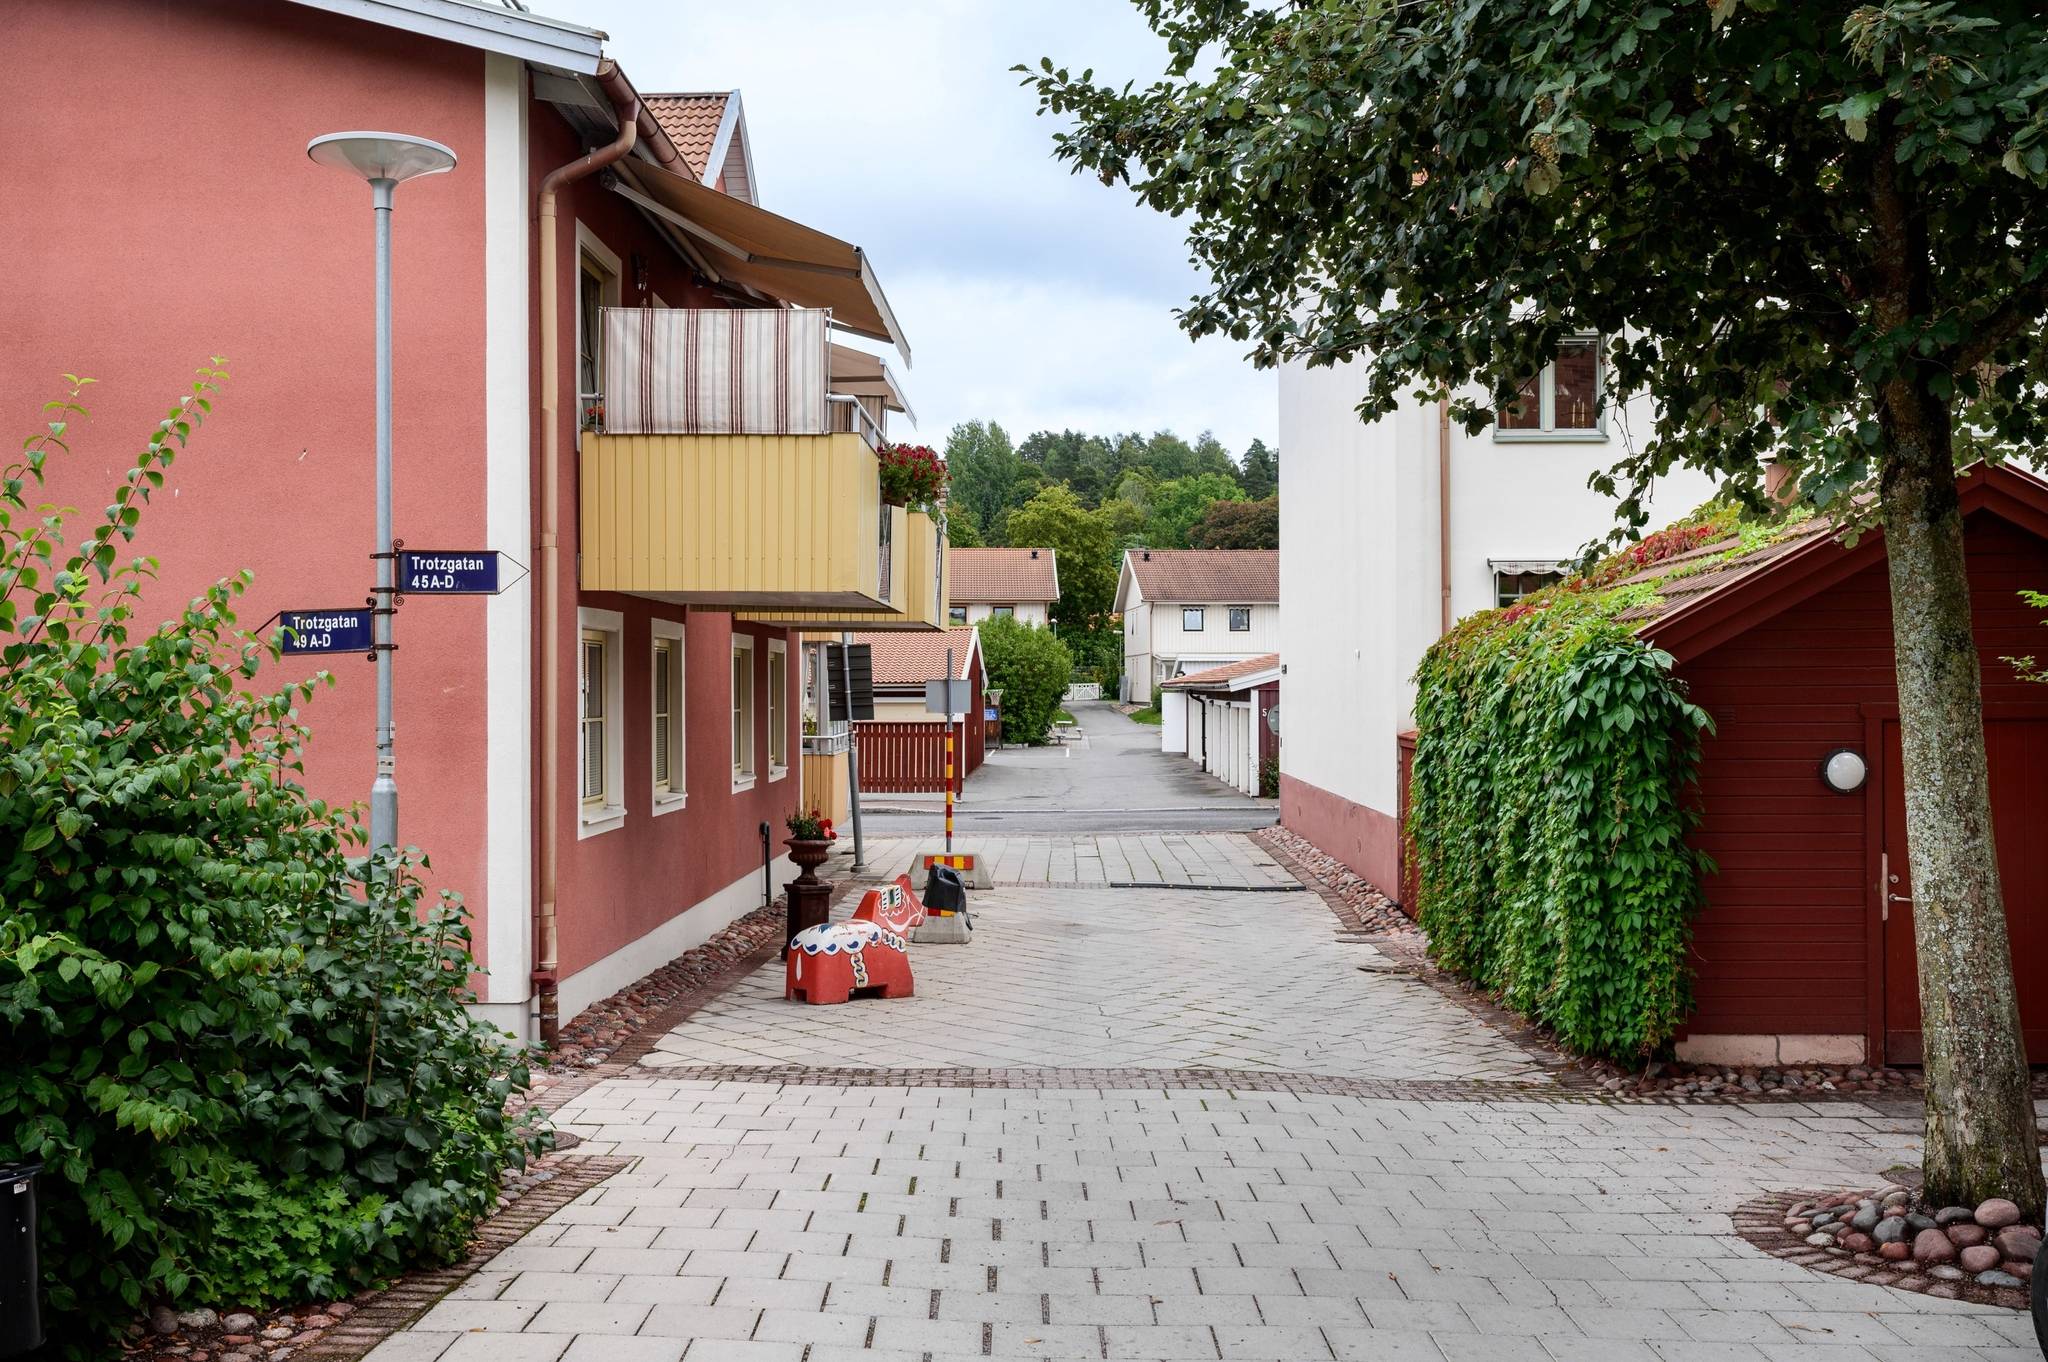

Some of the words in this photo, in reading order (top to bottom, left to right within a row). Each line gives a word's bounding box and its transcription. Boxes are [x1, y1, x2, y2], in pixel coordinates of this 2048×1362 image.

[411, 556, 484, 573] Trotzgatan
[411, 574, 429, 589] 45
[430, 574, 455, 589] A-D
[292, 615, 358, 632] Trotzgatan
[309, 633, 332, 648] A-D
[1262, 708, 1268, 717] 5
